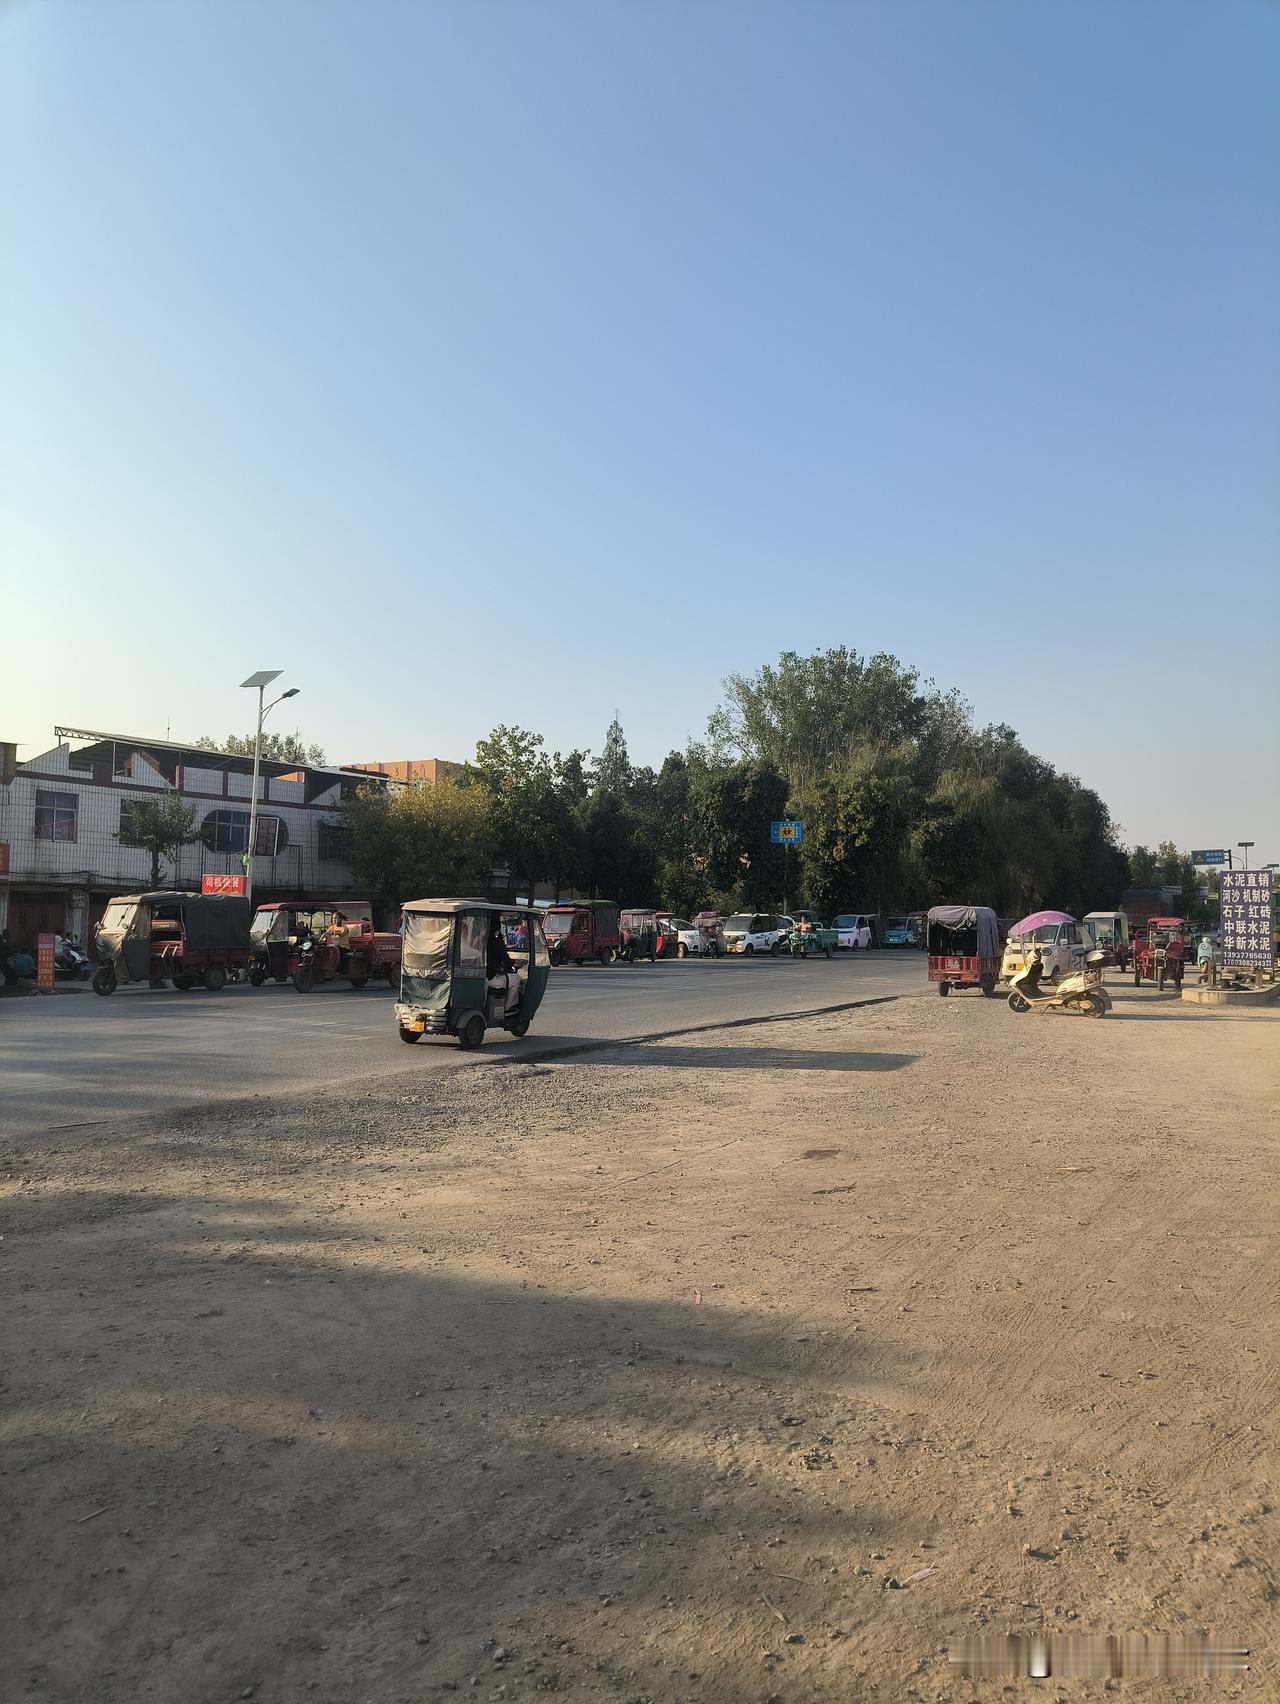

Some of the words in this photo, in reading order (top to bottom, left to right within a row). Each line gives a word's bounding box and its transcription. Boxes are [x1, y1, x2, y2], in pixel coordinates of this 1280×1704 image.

[1223, 873, 1269, 887] 水泥直销
[1222, 889, 1241, 903] 河沙
[1243, 889, 1270, 903] 机制砂
[1222, 905, 1245, 918] 石子
[1248, 905, 1271, 919] 红砖
[1224, 920, 1270, 935] 中联水泥
[1224, 936, 1270, 950] 华新水泥
[1223, 951, 1272, 960] 13937765630
